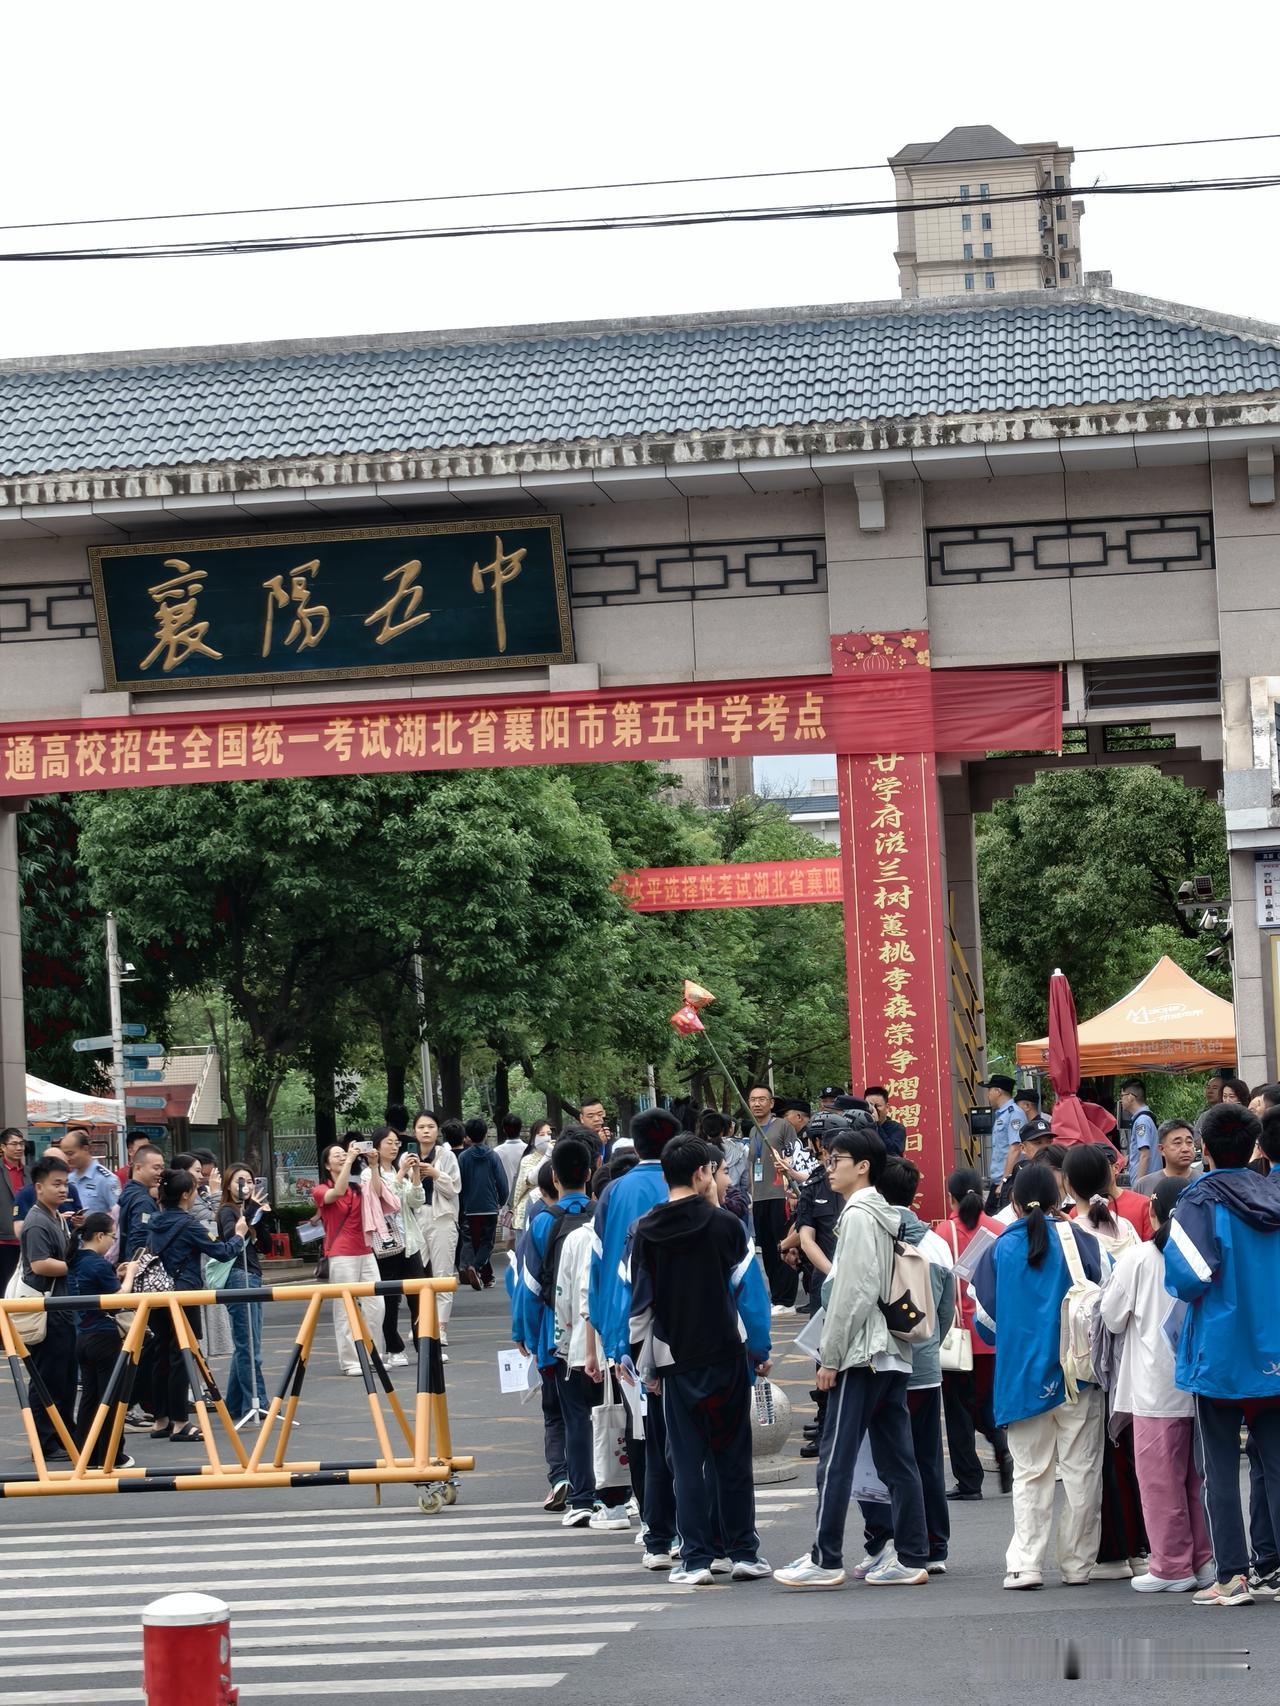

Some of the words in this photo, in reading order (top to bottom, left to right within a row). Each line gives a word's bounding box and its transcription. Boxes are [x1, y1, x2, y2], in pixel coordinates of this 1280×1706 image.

[4, 691, 827, 781] 通高校招生全国统一考试湖北省襄阳市第五中学考点
[869, 752, 925, 1209] 廿学府滋兰树蕙桃李森荣争熠熠
